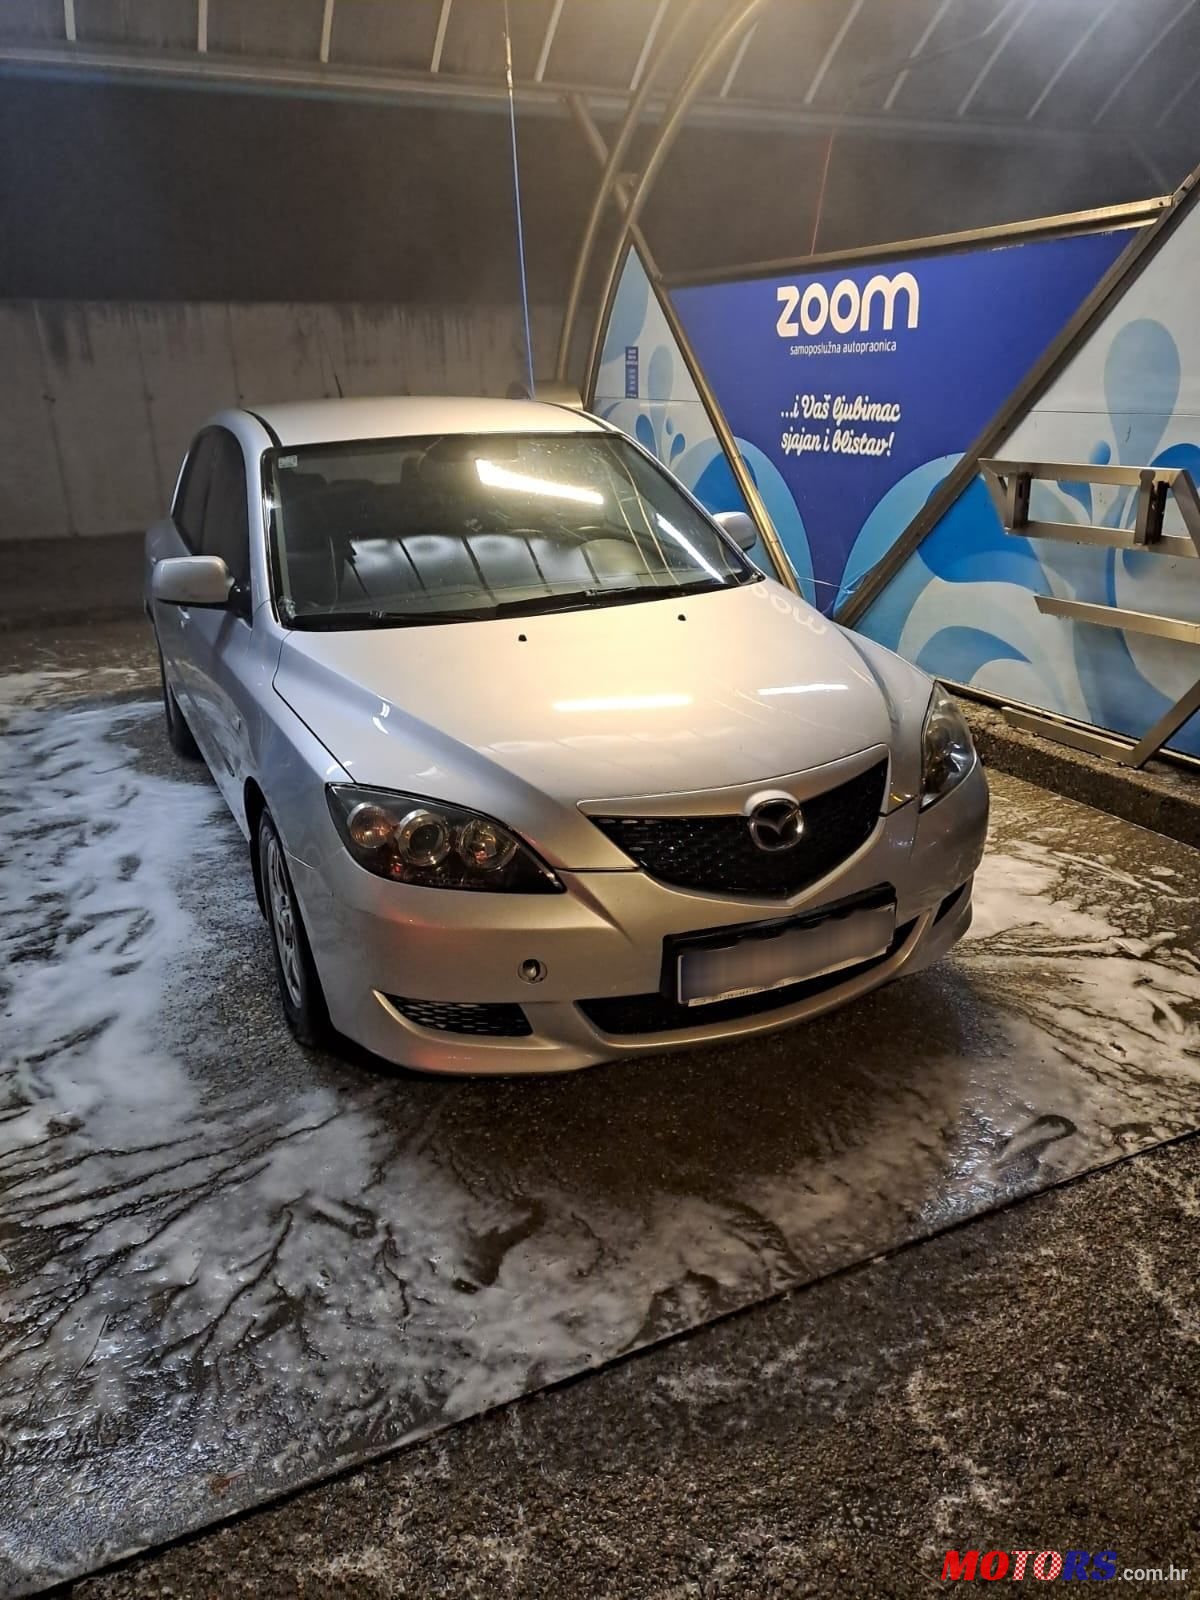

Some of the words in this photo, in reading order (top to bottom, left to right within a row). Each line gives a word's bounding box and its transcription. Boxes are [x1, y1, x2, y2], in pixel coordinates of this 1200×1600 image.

[776, 272, 920, 338] zoom
[790, 341, 841, 356] samoposlužna
[842, 339, 897, 354] autopraonica
[801, 394, 832, 420] Vaš
[832, 395, 901, 426] ljubimac
[781, 426, 822, 457] sjajan
[823, 428, 831, 452] i
[832, 429, 896, 457] blistav!
